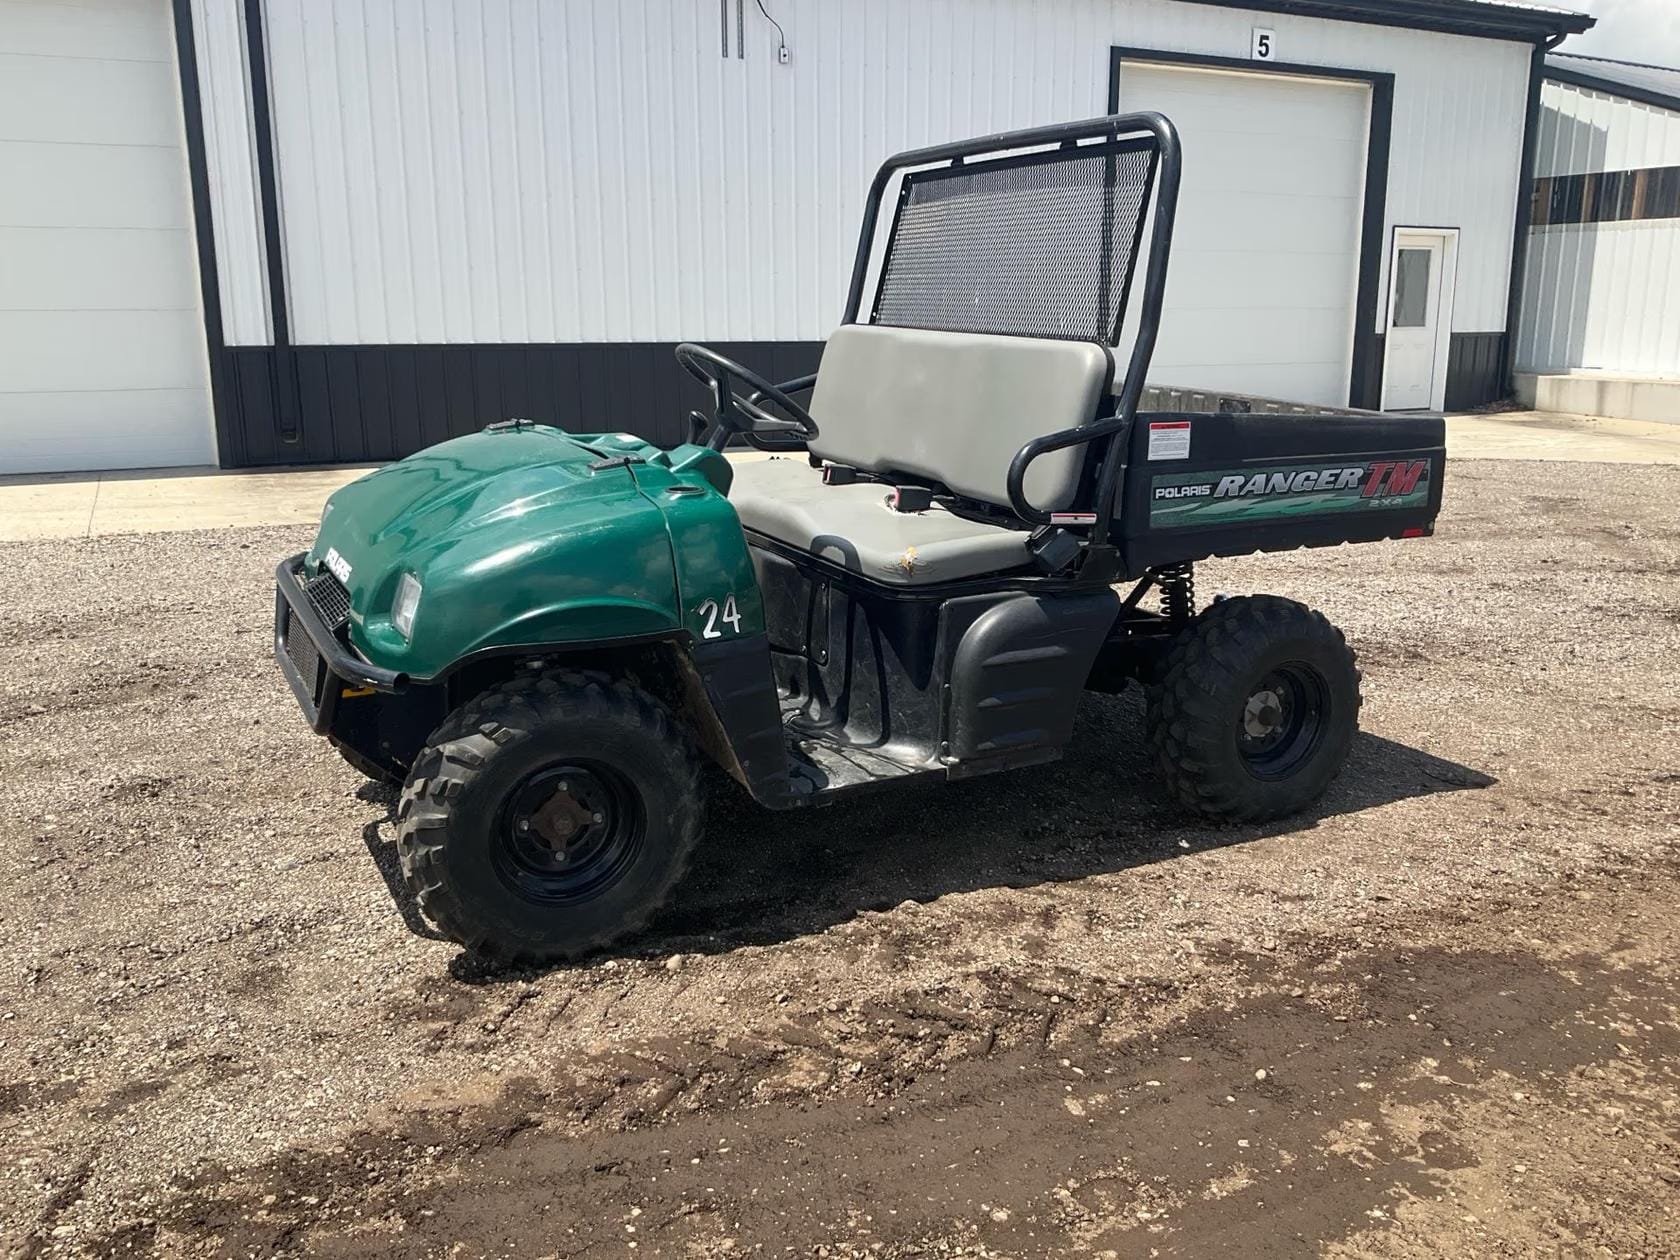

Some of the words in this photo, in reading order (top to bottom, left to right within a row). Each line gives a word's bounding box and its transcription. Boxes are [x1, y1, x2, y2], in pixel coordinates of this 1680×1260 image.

[1258, 35, 1270, 57] 5
[1155, 485, 1212, 499] POLARIS
[1213, 467, 1364, 498] RANGER
[1361, 460, 1427, 498] TM
[698, 594, 741, 639] 24
